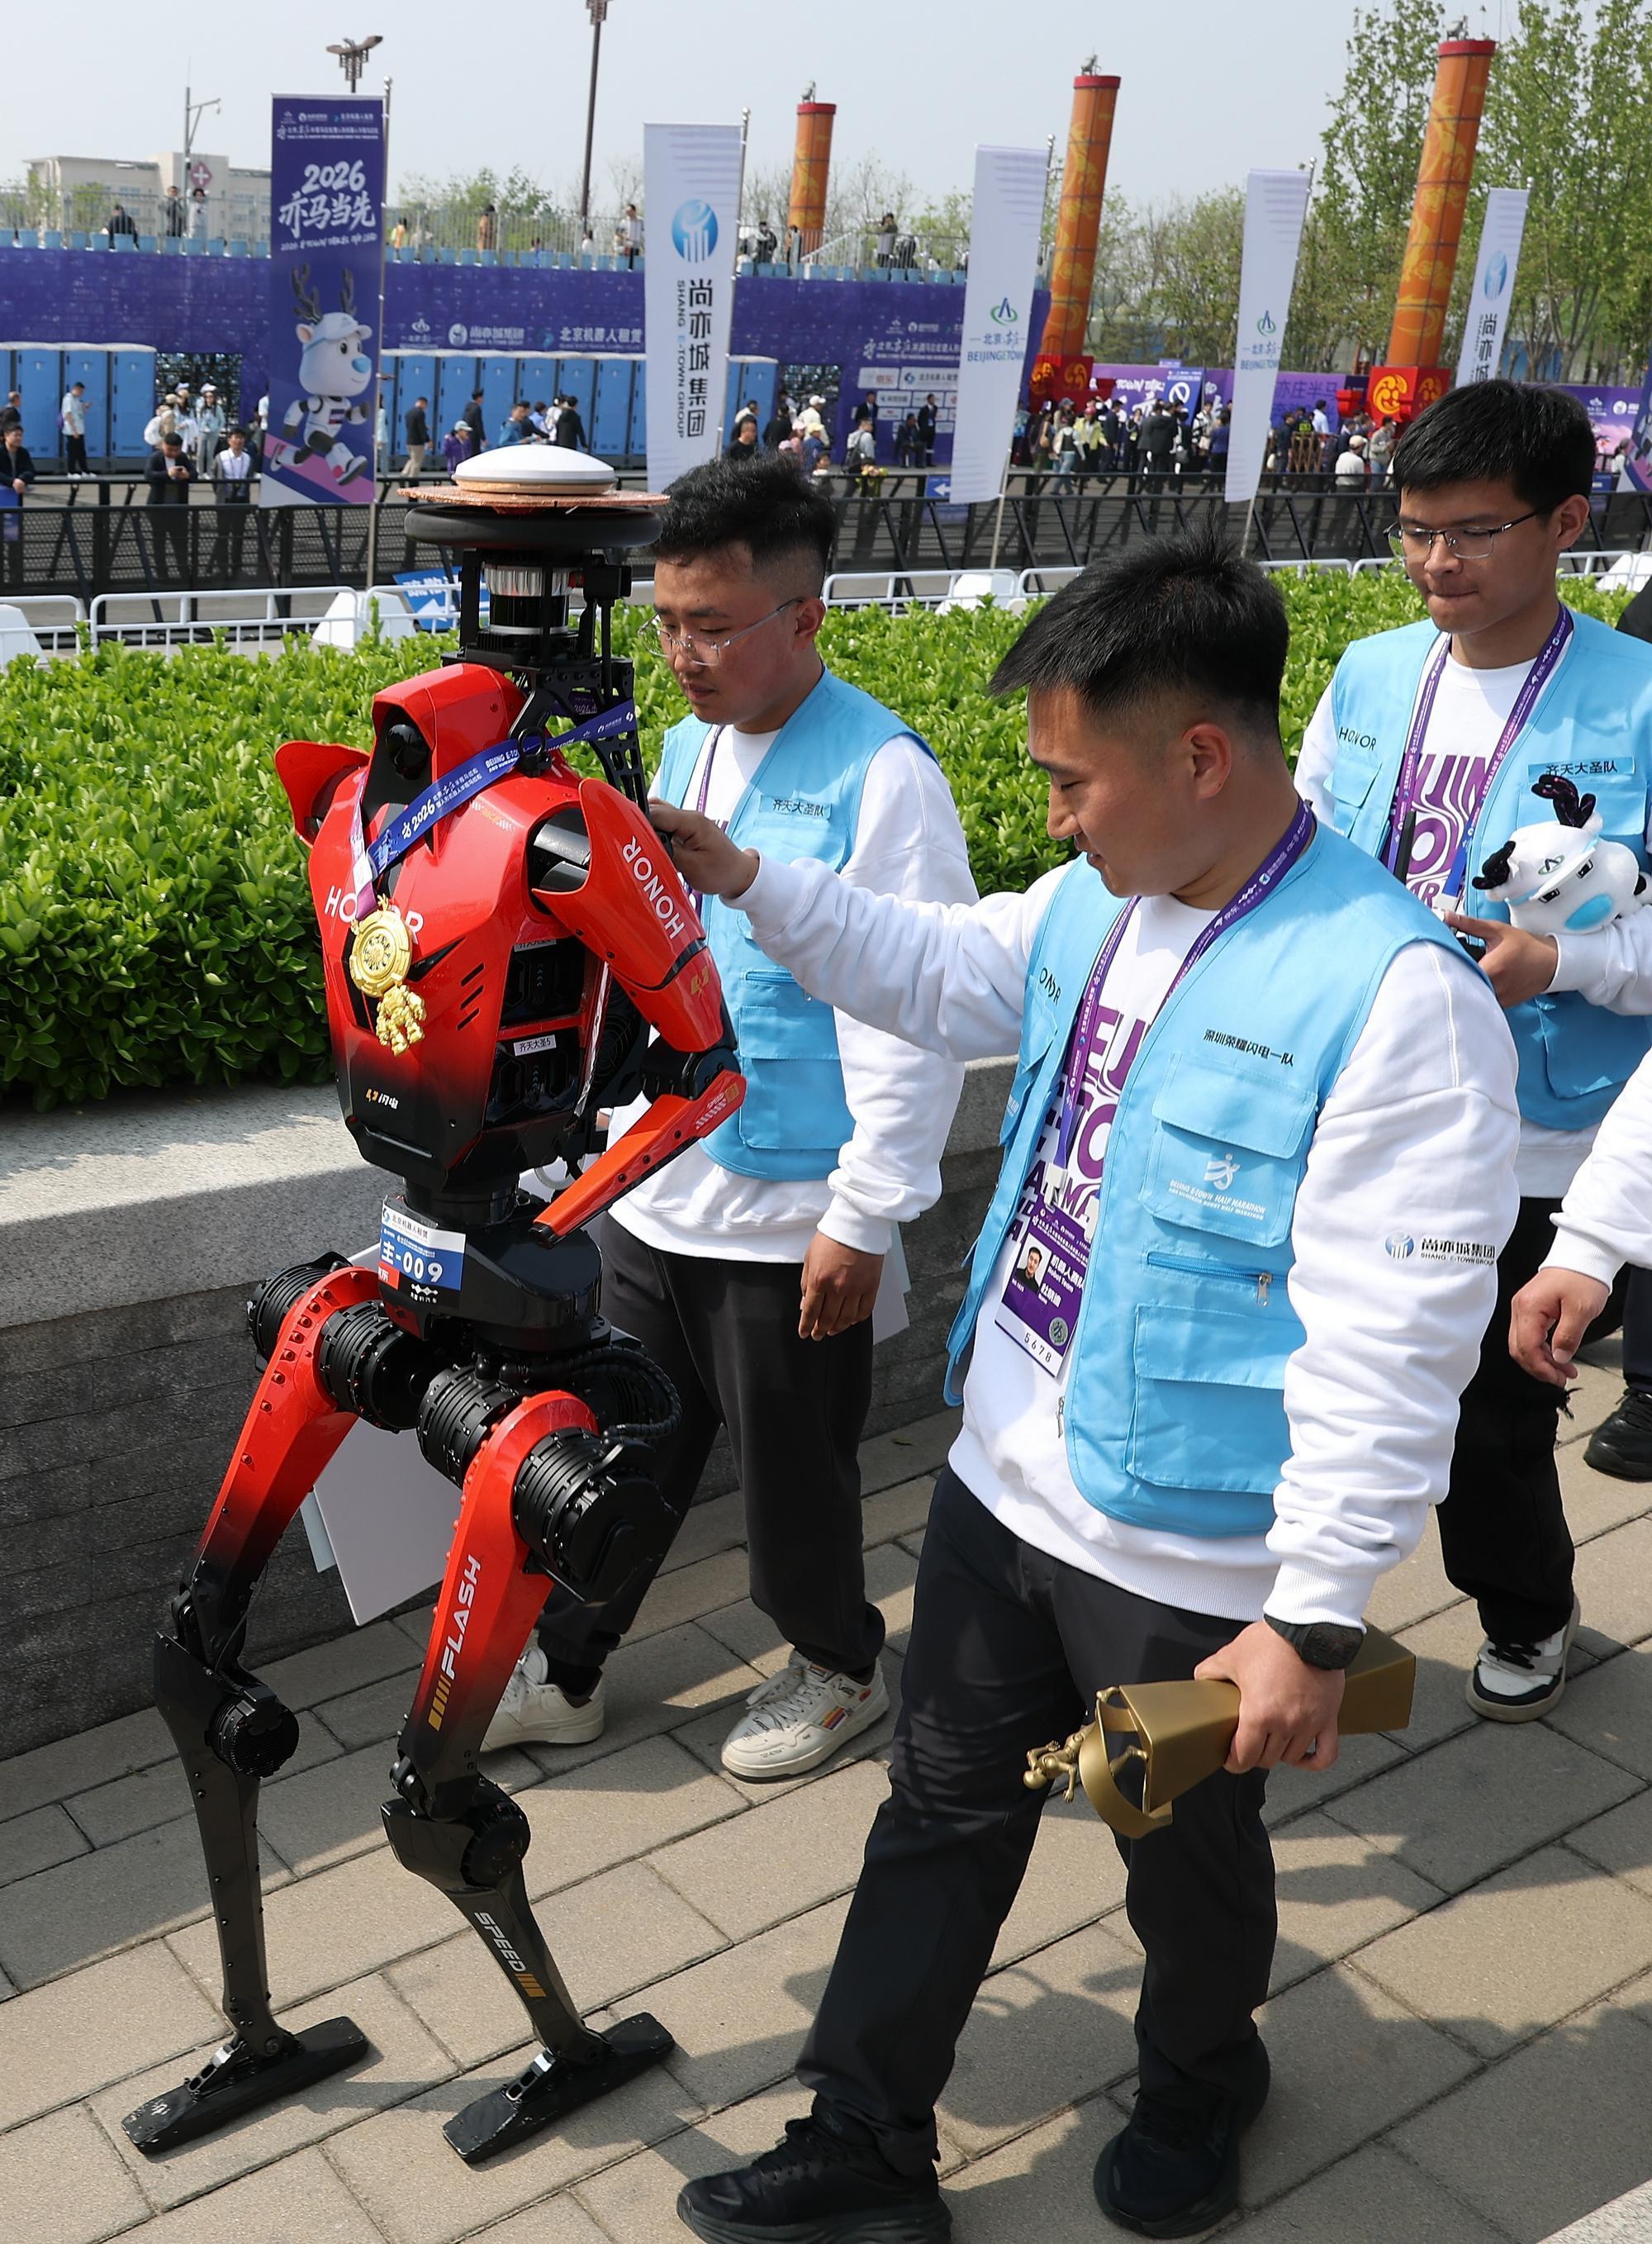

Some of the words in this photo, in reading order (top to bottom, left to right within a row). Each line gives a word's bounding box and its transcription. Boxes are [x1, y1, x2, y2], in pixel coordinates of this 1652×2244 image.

[301, 159, 366, 194] 2026
[278, 190, 376, 239] 亦马当先
[677, 279, 686, 327] SHANG
[677, 335, 686, 387] E-TOWN
[687, 278, 712, 437] 尚亦城集团
[1475, 313, 1498, 383] 尚亦城
[1339, 726, 1377, 751] HONOR
[1546, 759, 1618, 776] 齐天大圣队
[411, 798, 436, 833] 2026
[772, 798, 825, 817] 齐天大圣队
[622, 835, 686, 939] HONOR
[325, 885, 425, 944] HOR
[520, 1037, 551, 1053] 齐天大圣5
[1203, 1029, 1294, 1067] 深圳荣耀闪电一队
[1232, 1199, 1266, 1215] MARATHON
[1421, 1238, 1496, 1258] 尚亦城集团
[1421, 1253, 1446, 1261] SHANG
[1475, 1258, 1495, 1267] GROUP
[1047, 1265, 1061, 1283] Robot
[1061, 1278, 1075, 1294] Team
[1024, 1333, 1051, 1363] 5678
[441, 1554, 482, 1681] FLASH
[474, 1912, 527, 1973] SPEED
